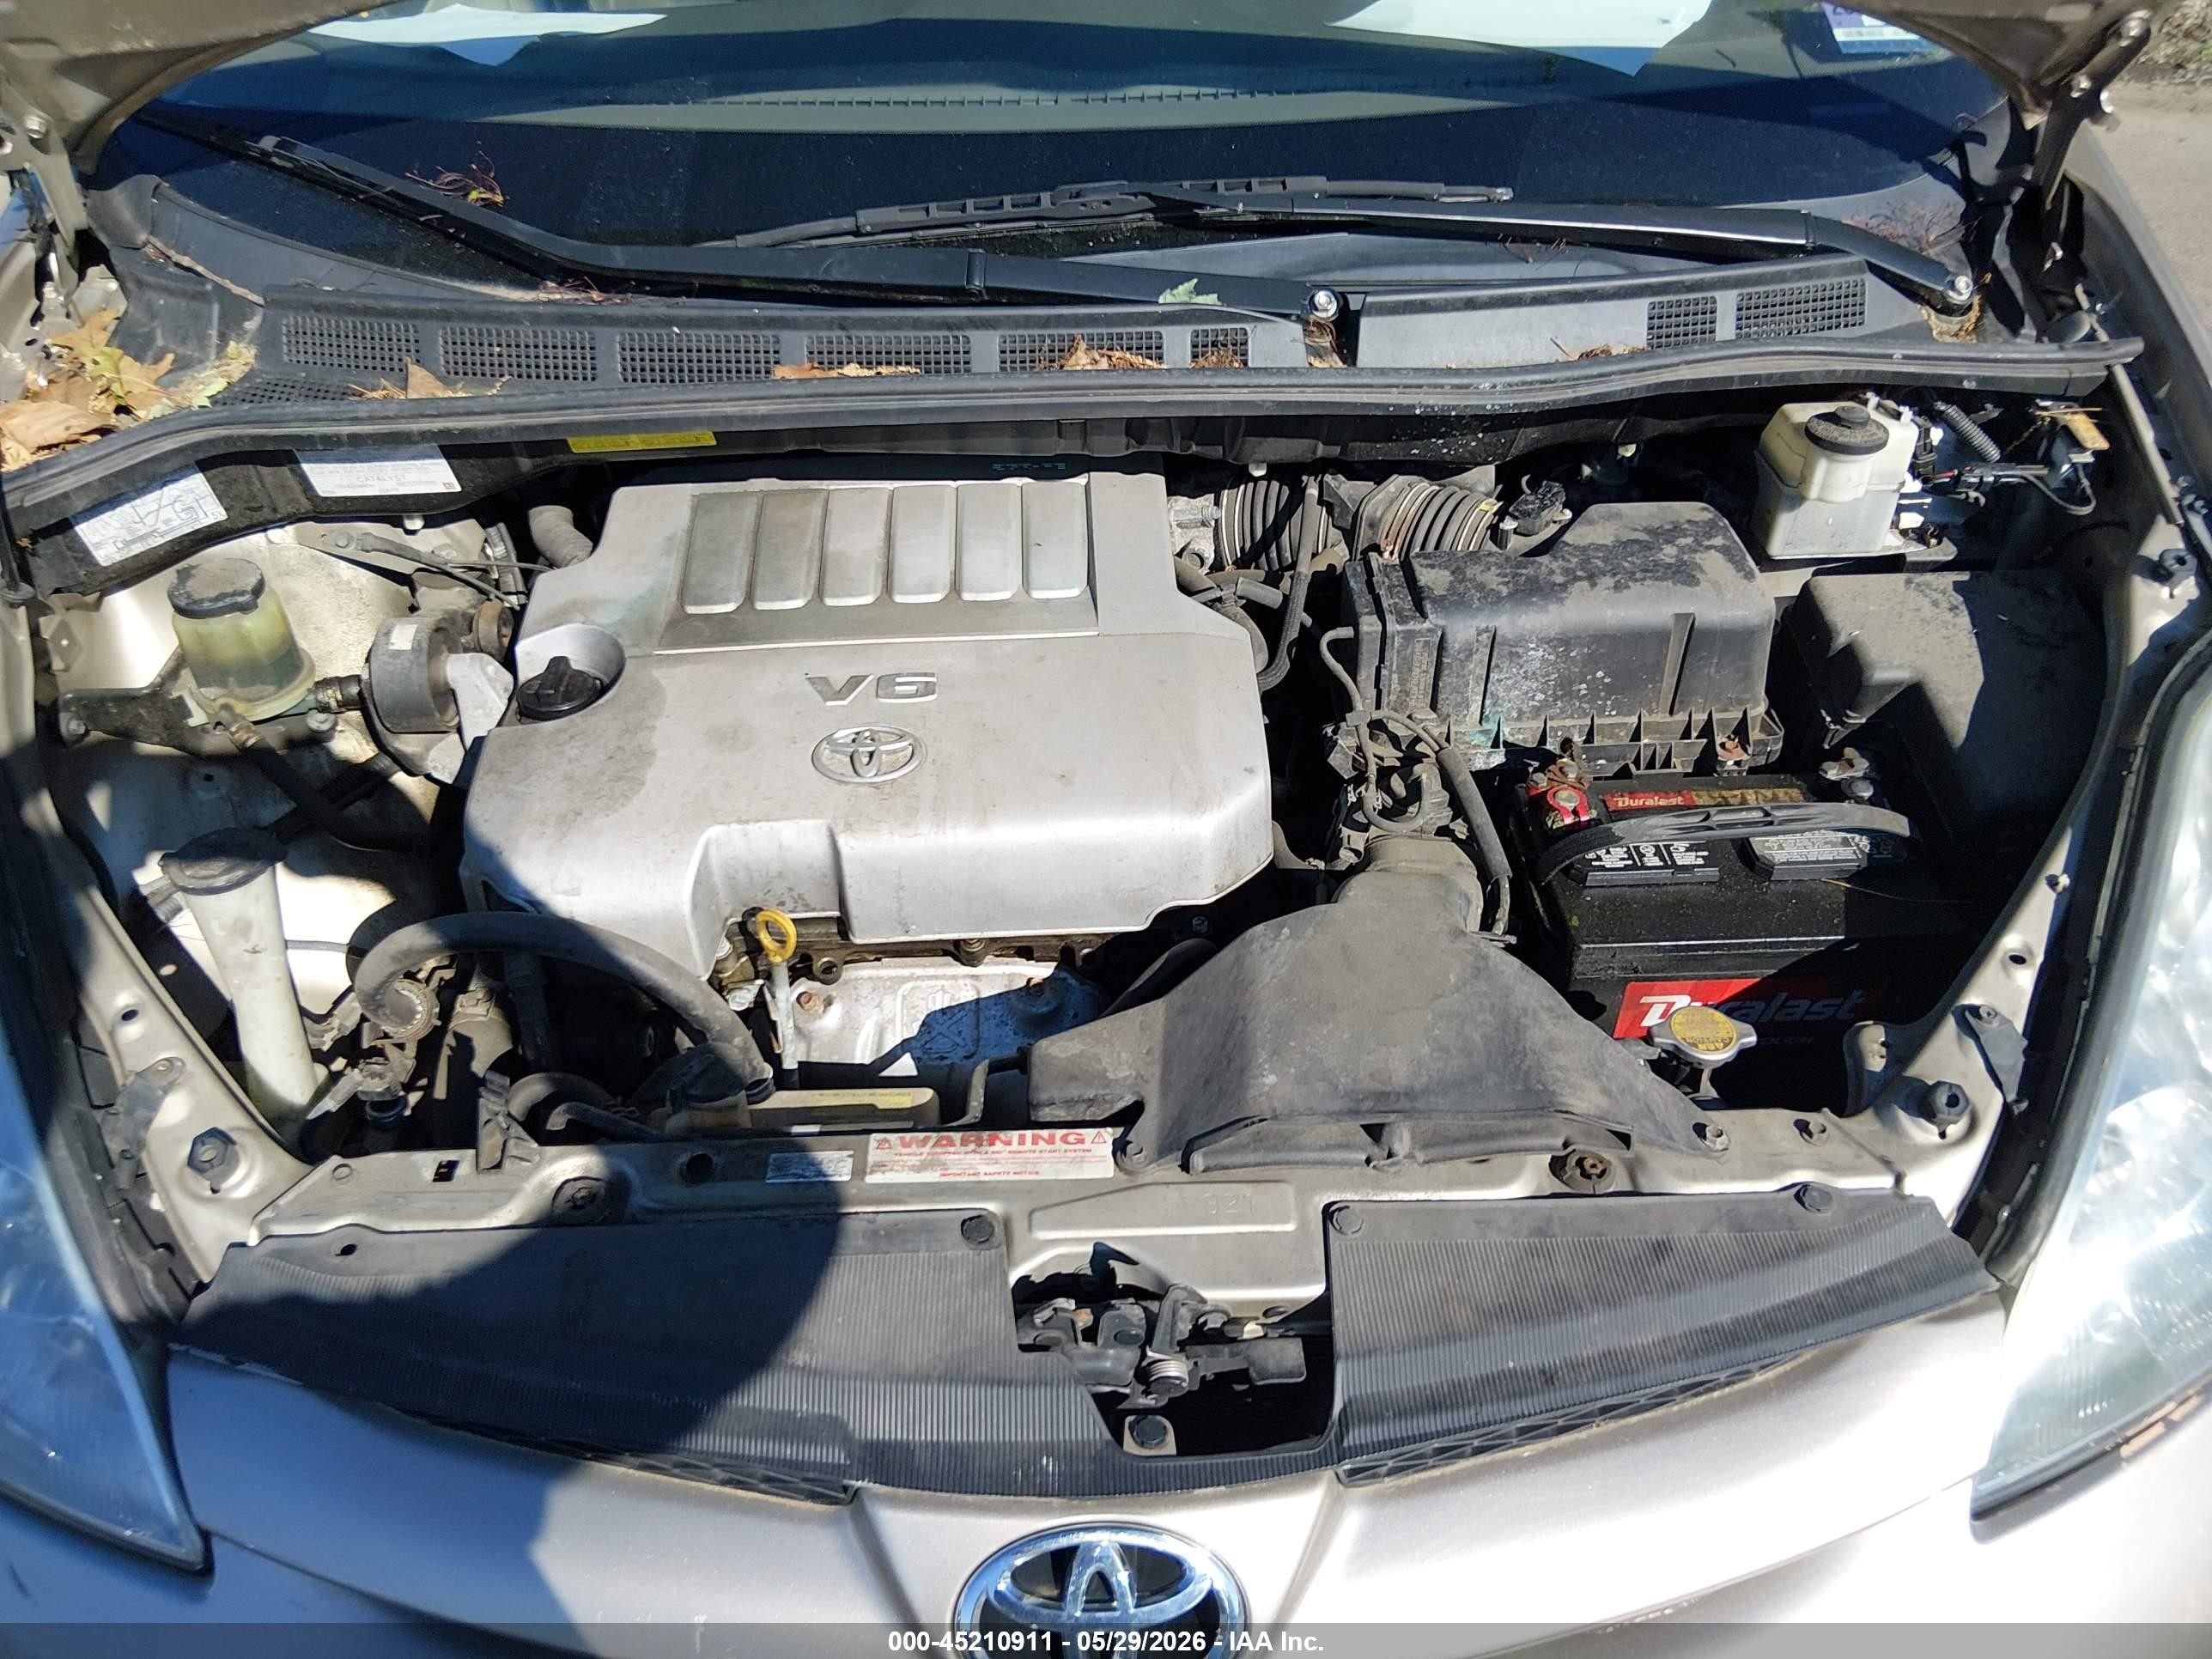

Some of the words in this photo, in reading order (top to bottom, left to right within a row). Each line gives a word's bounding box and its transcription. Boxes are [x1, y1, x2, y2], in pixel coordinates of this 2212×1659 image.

[805, 672, 938, 706] V6
[1613, 795, 1685, 807] Duralast
[1640, 989, 1866, 1027] Dralast
[898, 1132, 1086, 1148] WARNING
